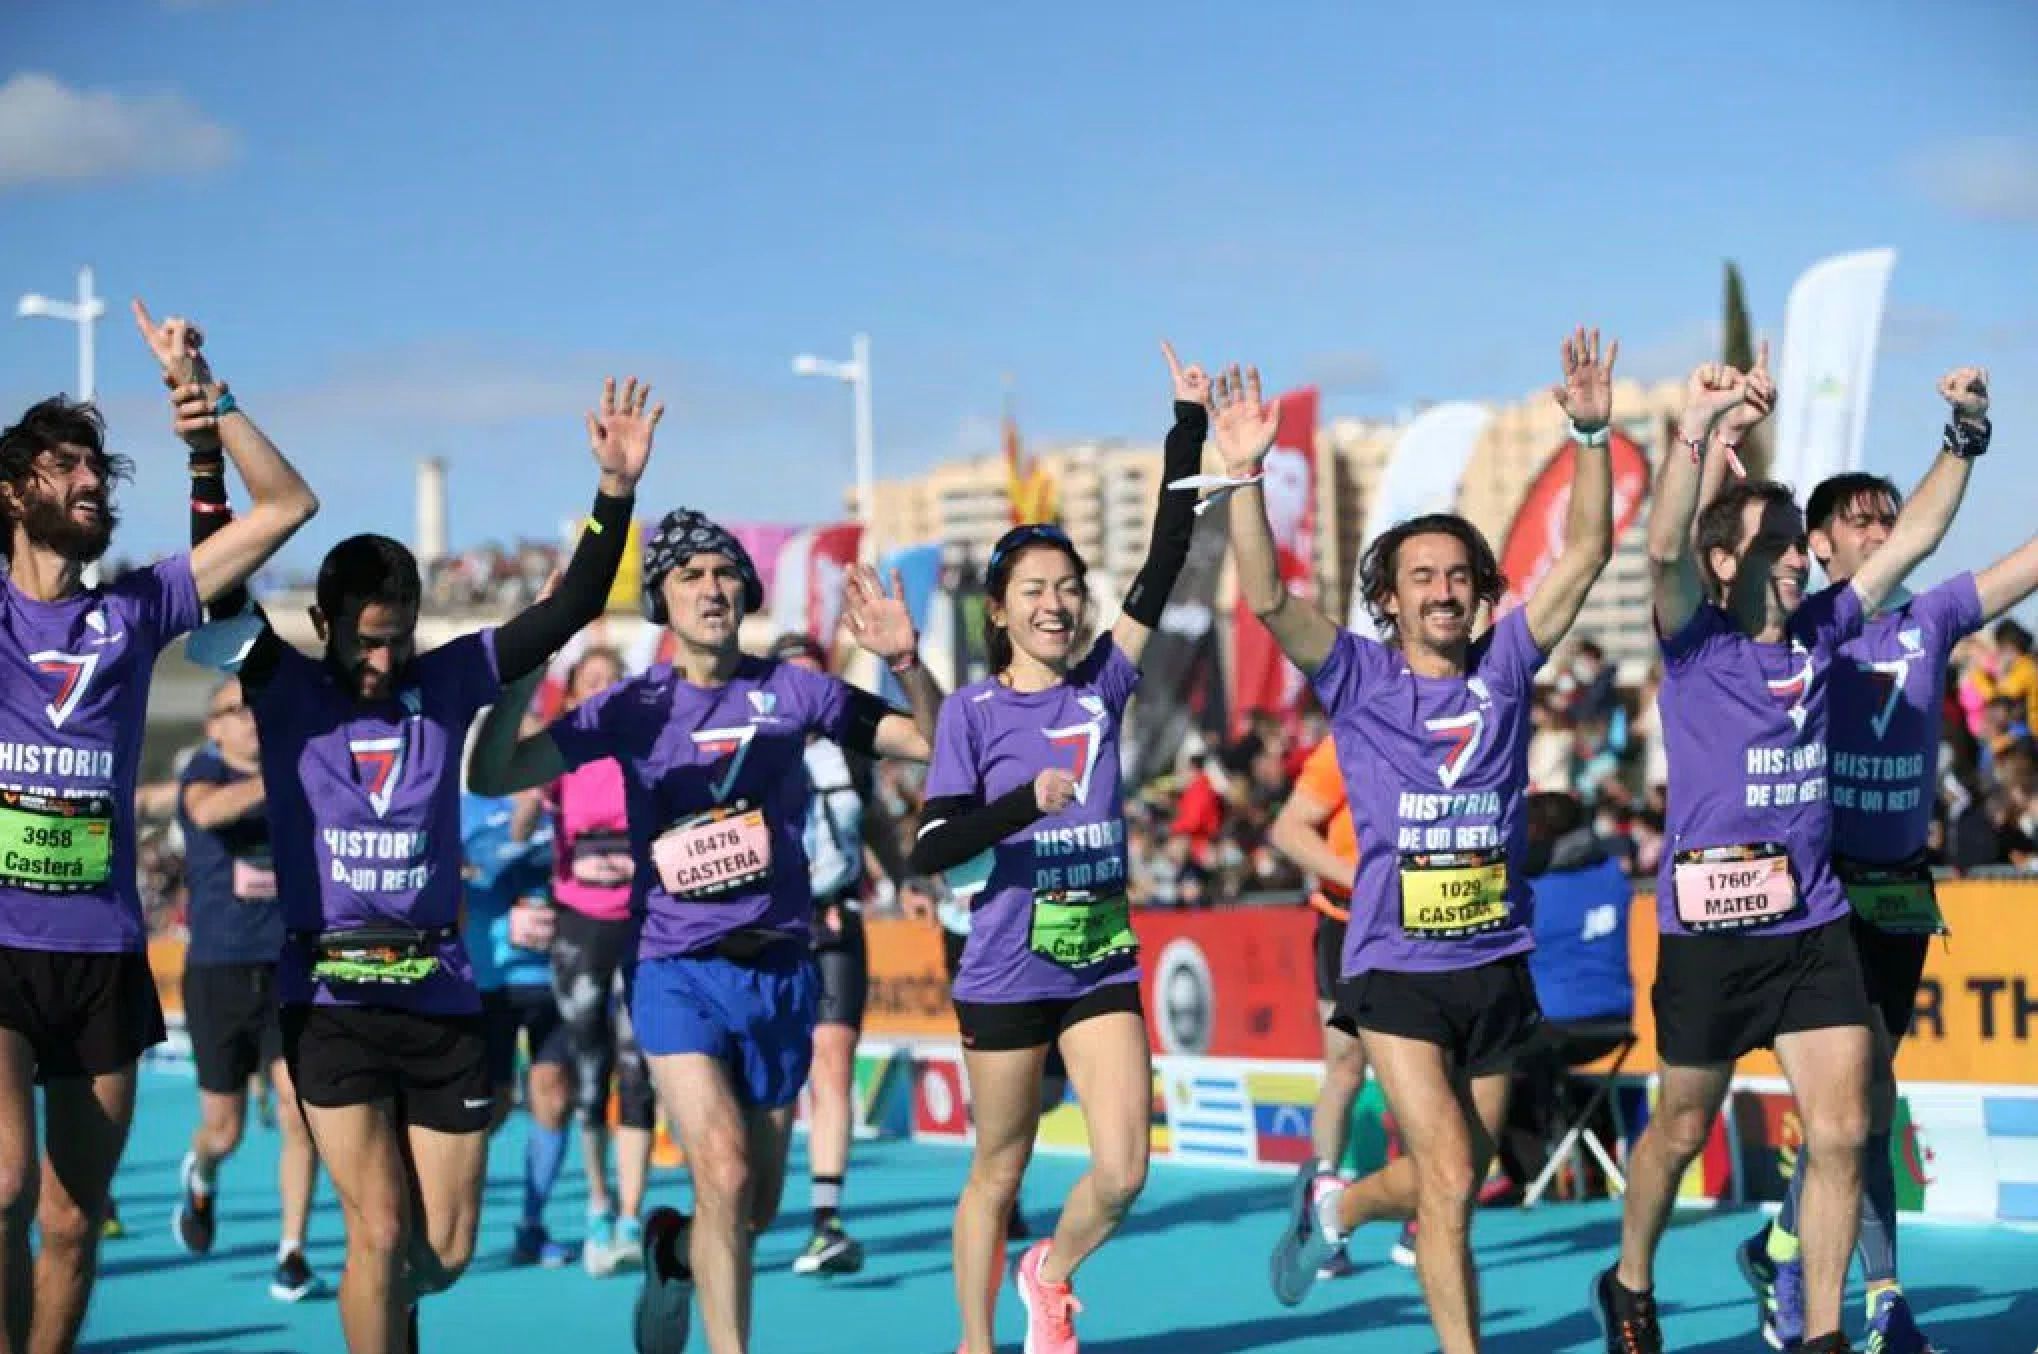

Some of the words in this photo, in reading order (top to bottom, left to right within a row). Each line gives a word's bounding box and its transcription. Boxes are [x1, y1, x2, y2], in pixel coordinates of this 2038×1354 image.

[1399, 792, 1500, 821] HISTORIA
[1746, 784, 1771, 807] DE
[1834, 787, 1857, 808] DE
[23, 826, 73, 848] 3958
[1399, 826, 1421, 849] DE
[1426, 827, 1450, 849] UN
[5, 851, 83, 876] Casterá
[332, 858, 351, 883] D
[352, 870, 376, 891] UN
[1036, 869, 1062, 889] DE
[1440, 879, 1481, 898] 1029
[1704, 893, 1768, 915] MATEO
